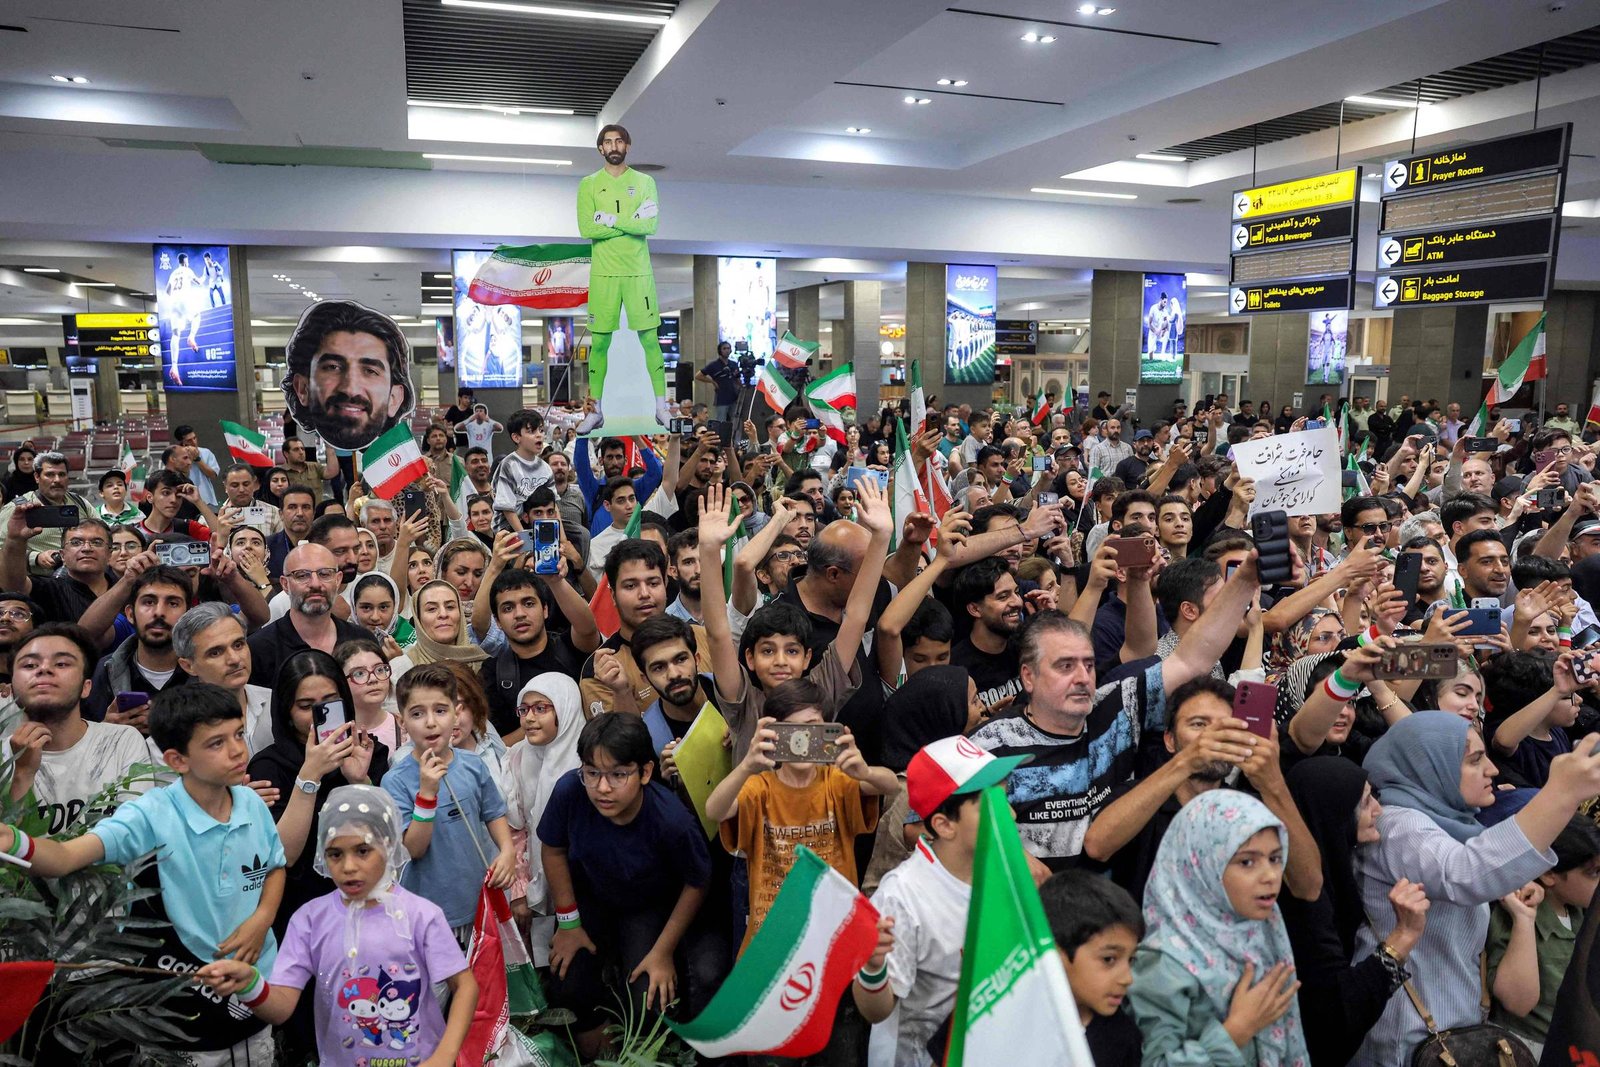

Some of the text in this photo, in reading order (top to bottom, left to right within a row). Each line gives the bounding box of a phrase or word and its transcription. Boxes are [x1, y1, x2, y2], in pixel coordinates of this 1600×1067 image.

[1433, 152, 1467, 165] نمازخانه
[1432, 166, 1484, 181] Prayer Rooms
[615, 199, 620, 213] 1
[1266, 218, 1294, 232] آشامیدنی
[1299, 215, 1321, 228] خوراکی
[1265, 234, 1279, 243] Food
[1284, 231, 1313, 241] Beverages
[1427, 229, 1496, 246] دستگاه عابر بانک
[1426, 251, 1444, 260] ATM
[173, 277, 183, 291] 23
[1423, 273, 1460, 287] امانت بار
[1263, 287, 1288, 299] بهداشتی
[1422, 289, 1484, 302] Baggage Storage
[644, 296, 650, 310] 1
[1263, 301, 1281, 309] Toilets
[1029, 811, 1050, 820] LIKE
[1051, 810, 1064, 819] DO
[1065, 809, 1072, 818] IT
[1087, 786, 1112, 809] FSHION
[157, 954, 223, 1004] adias
[370, 1058, 408, 1067] KUROMI
